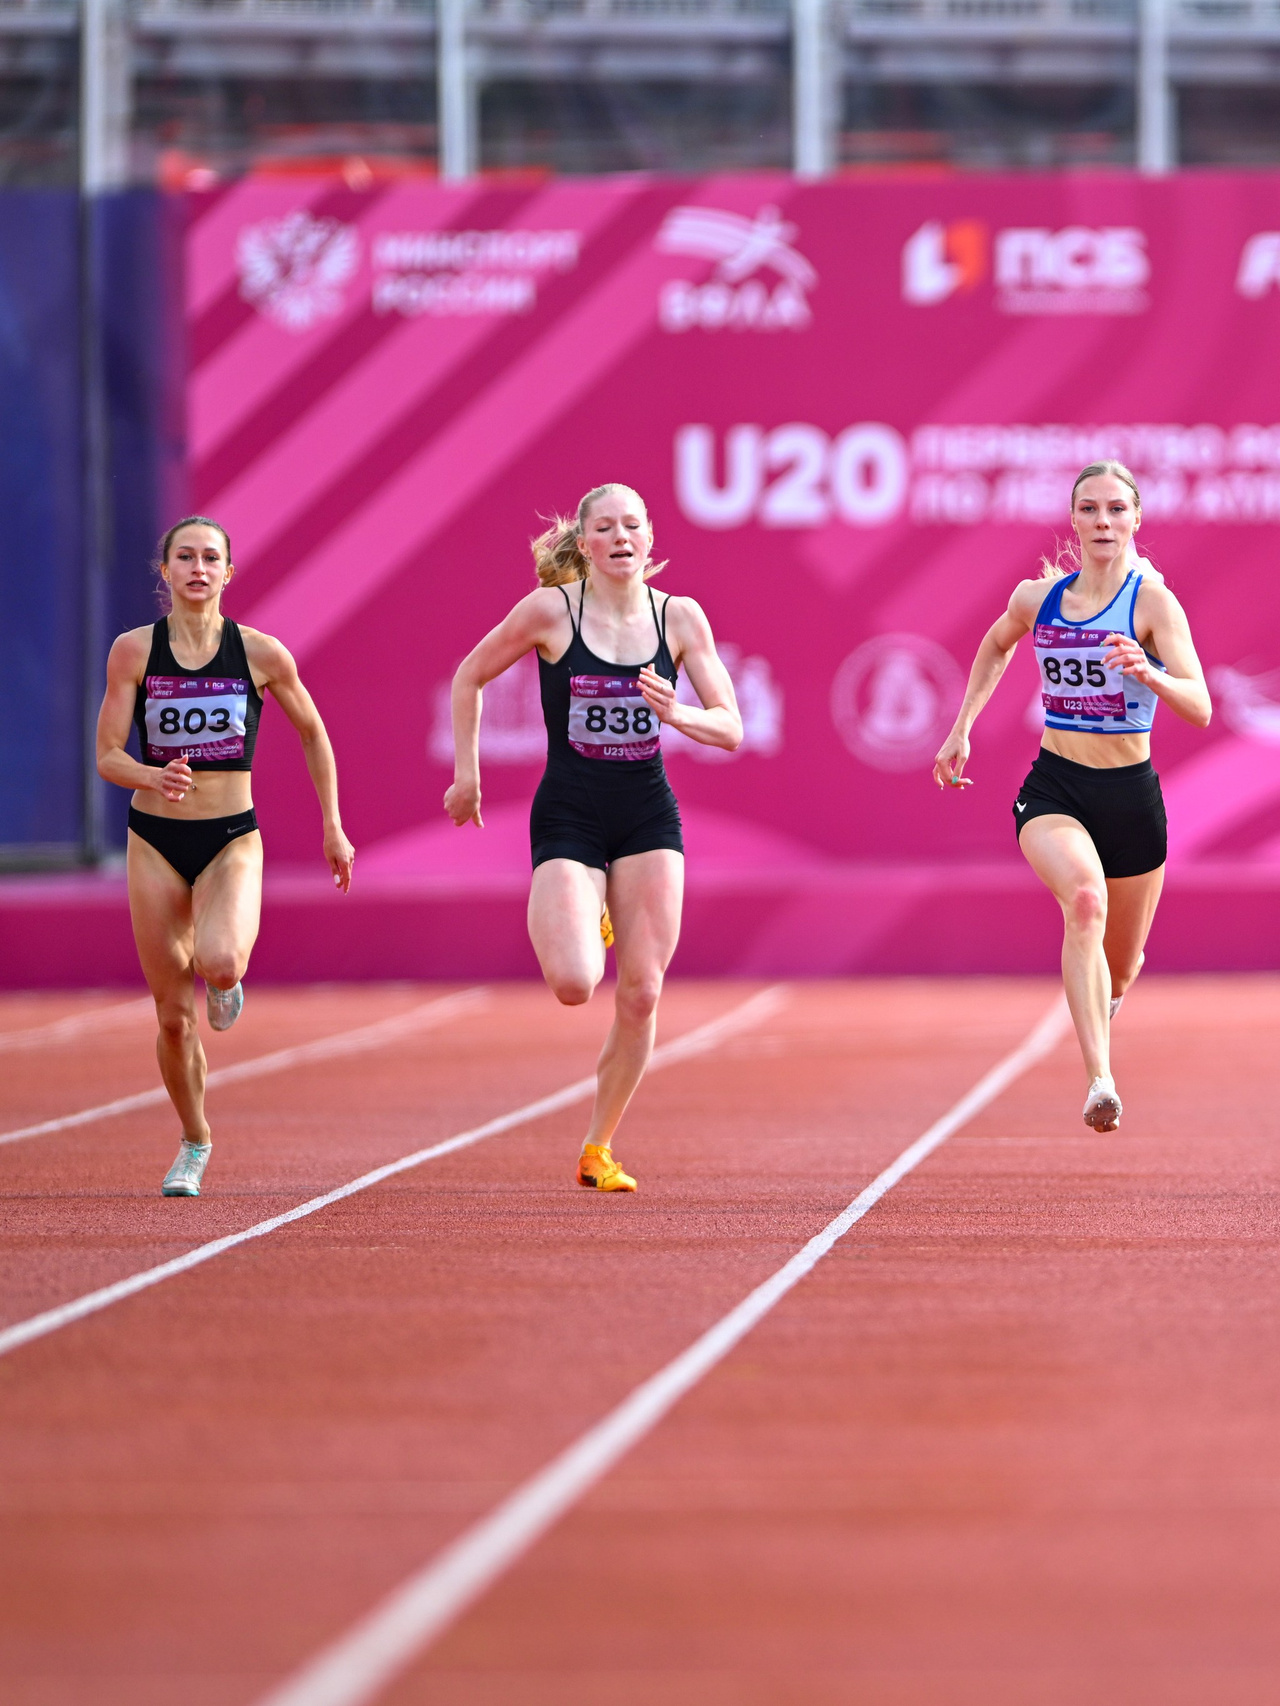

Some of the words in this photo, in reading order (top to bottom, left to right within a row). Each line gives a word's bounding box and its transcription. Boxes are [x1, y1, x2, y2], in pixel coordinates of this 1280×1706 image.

[996, 228, 1150, 291] ПСБ
[674, 422, 906, 528] U20
[1043, 656, 1106, 687] 835
[1063, 699, 1083, 711] U23
[159, 707, 230, 735] 803
[585, 705, 652, 734] 838
[180, 748, 202, 758] U23
[603, 746, 625, 757] U23
